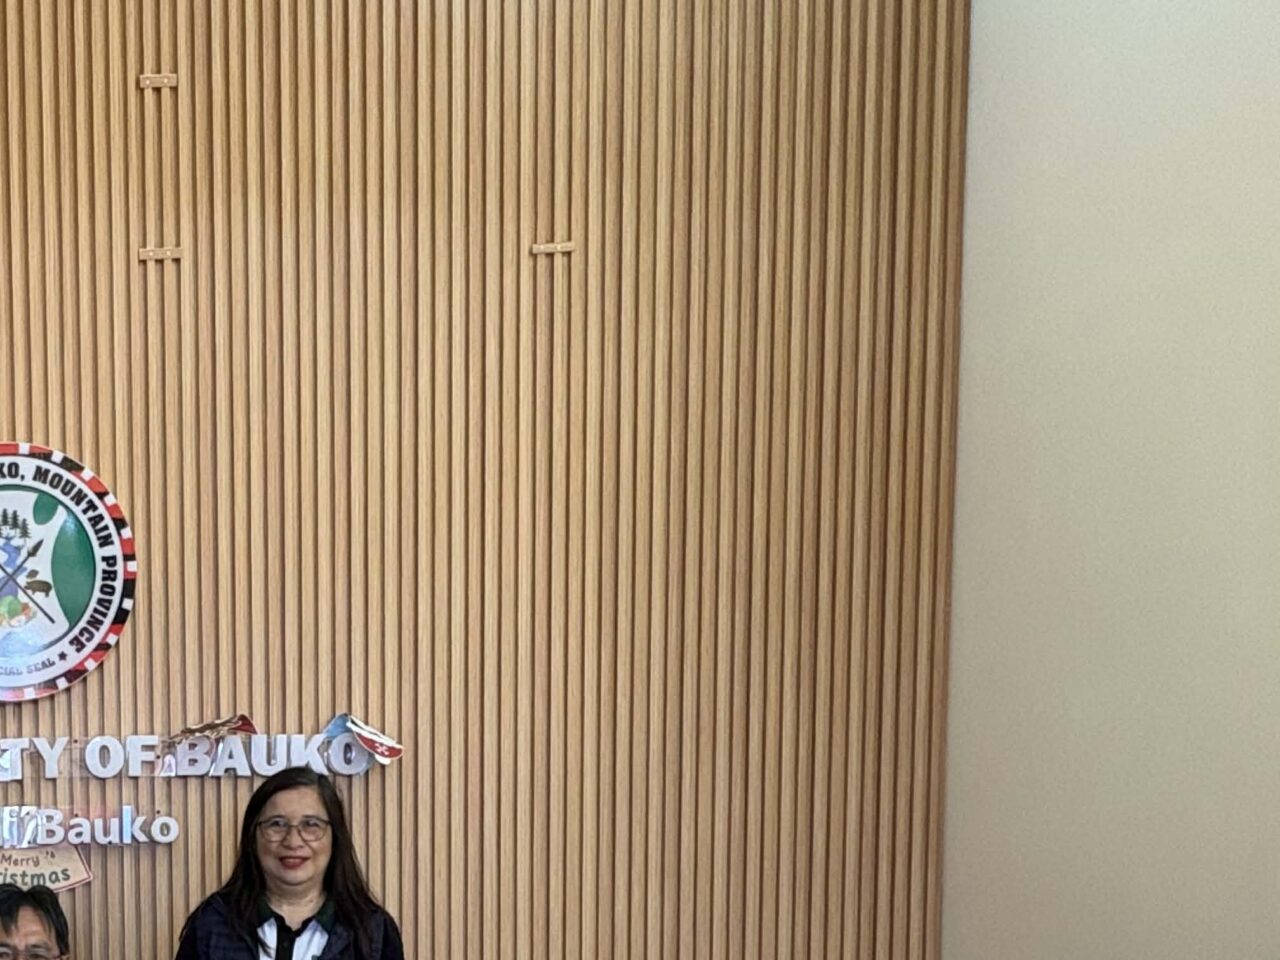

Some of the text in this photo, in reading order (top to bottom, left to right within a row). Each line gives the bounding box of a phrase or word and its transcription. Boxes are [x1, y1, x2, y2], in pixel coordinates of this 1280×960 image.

[32, 465, 114, 549] MOUNTAIN
[68, 555, 118, 654] PROVINCE
[26, 656, 56, 675] SEAL
[84, 735, 159, 778] OF
[175, 733, 371, 777] BAUKO
[36, 805, 180, 845] Bauko
[0, 852, 40, 867] Merry
